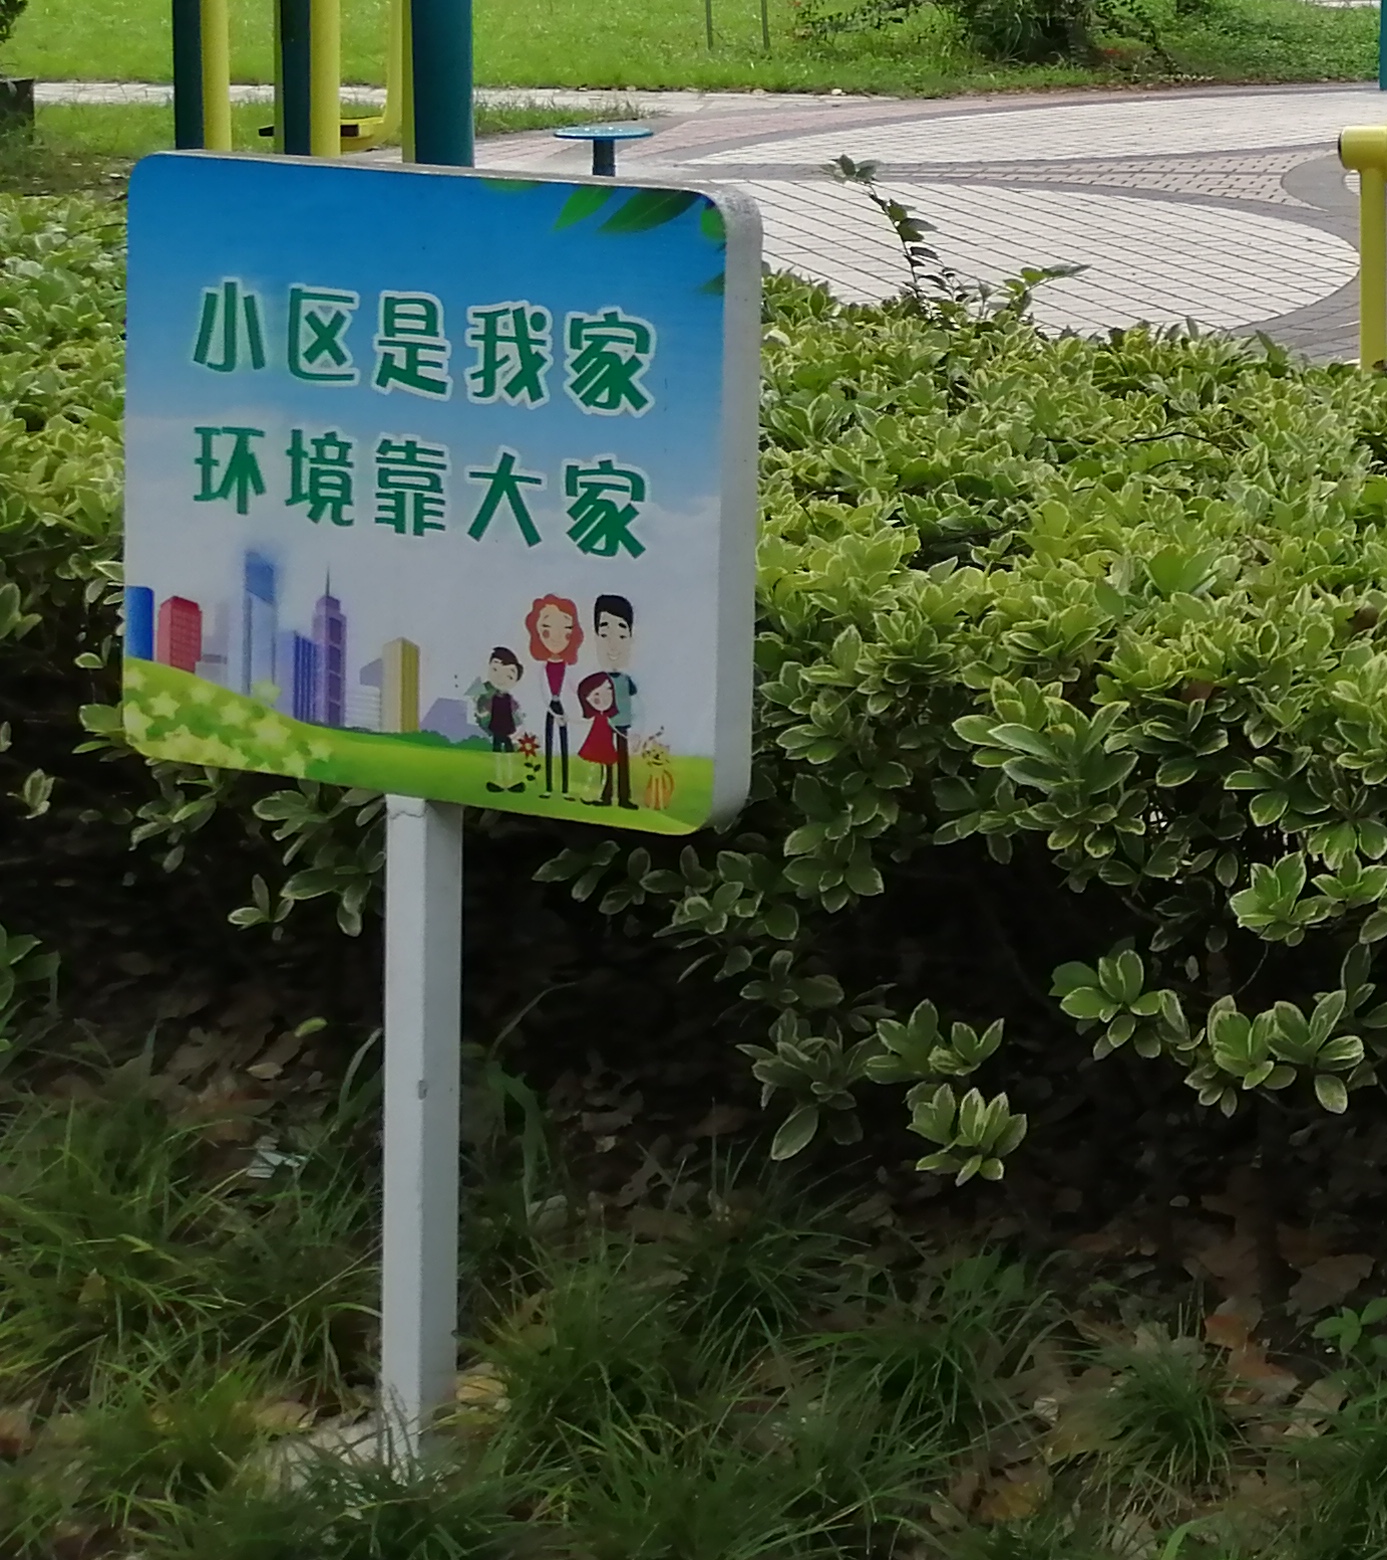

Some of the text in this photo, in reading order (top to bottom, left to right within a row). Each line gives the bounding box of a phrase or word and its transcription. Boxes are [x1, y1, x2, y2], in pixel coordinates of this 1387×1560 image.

[190, 278, 657, 416] 小区是我家
[193, 425, 647, 562] 环境靠大家
